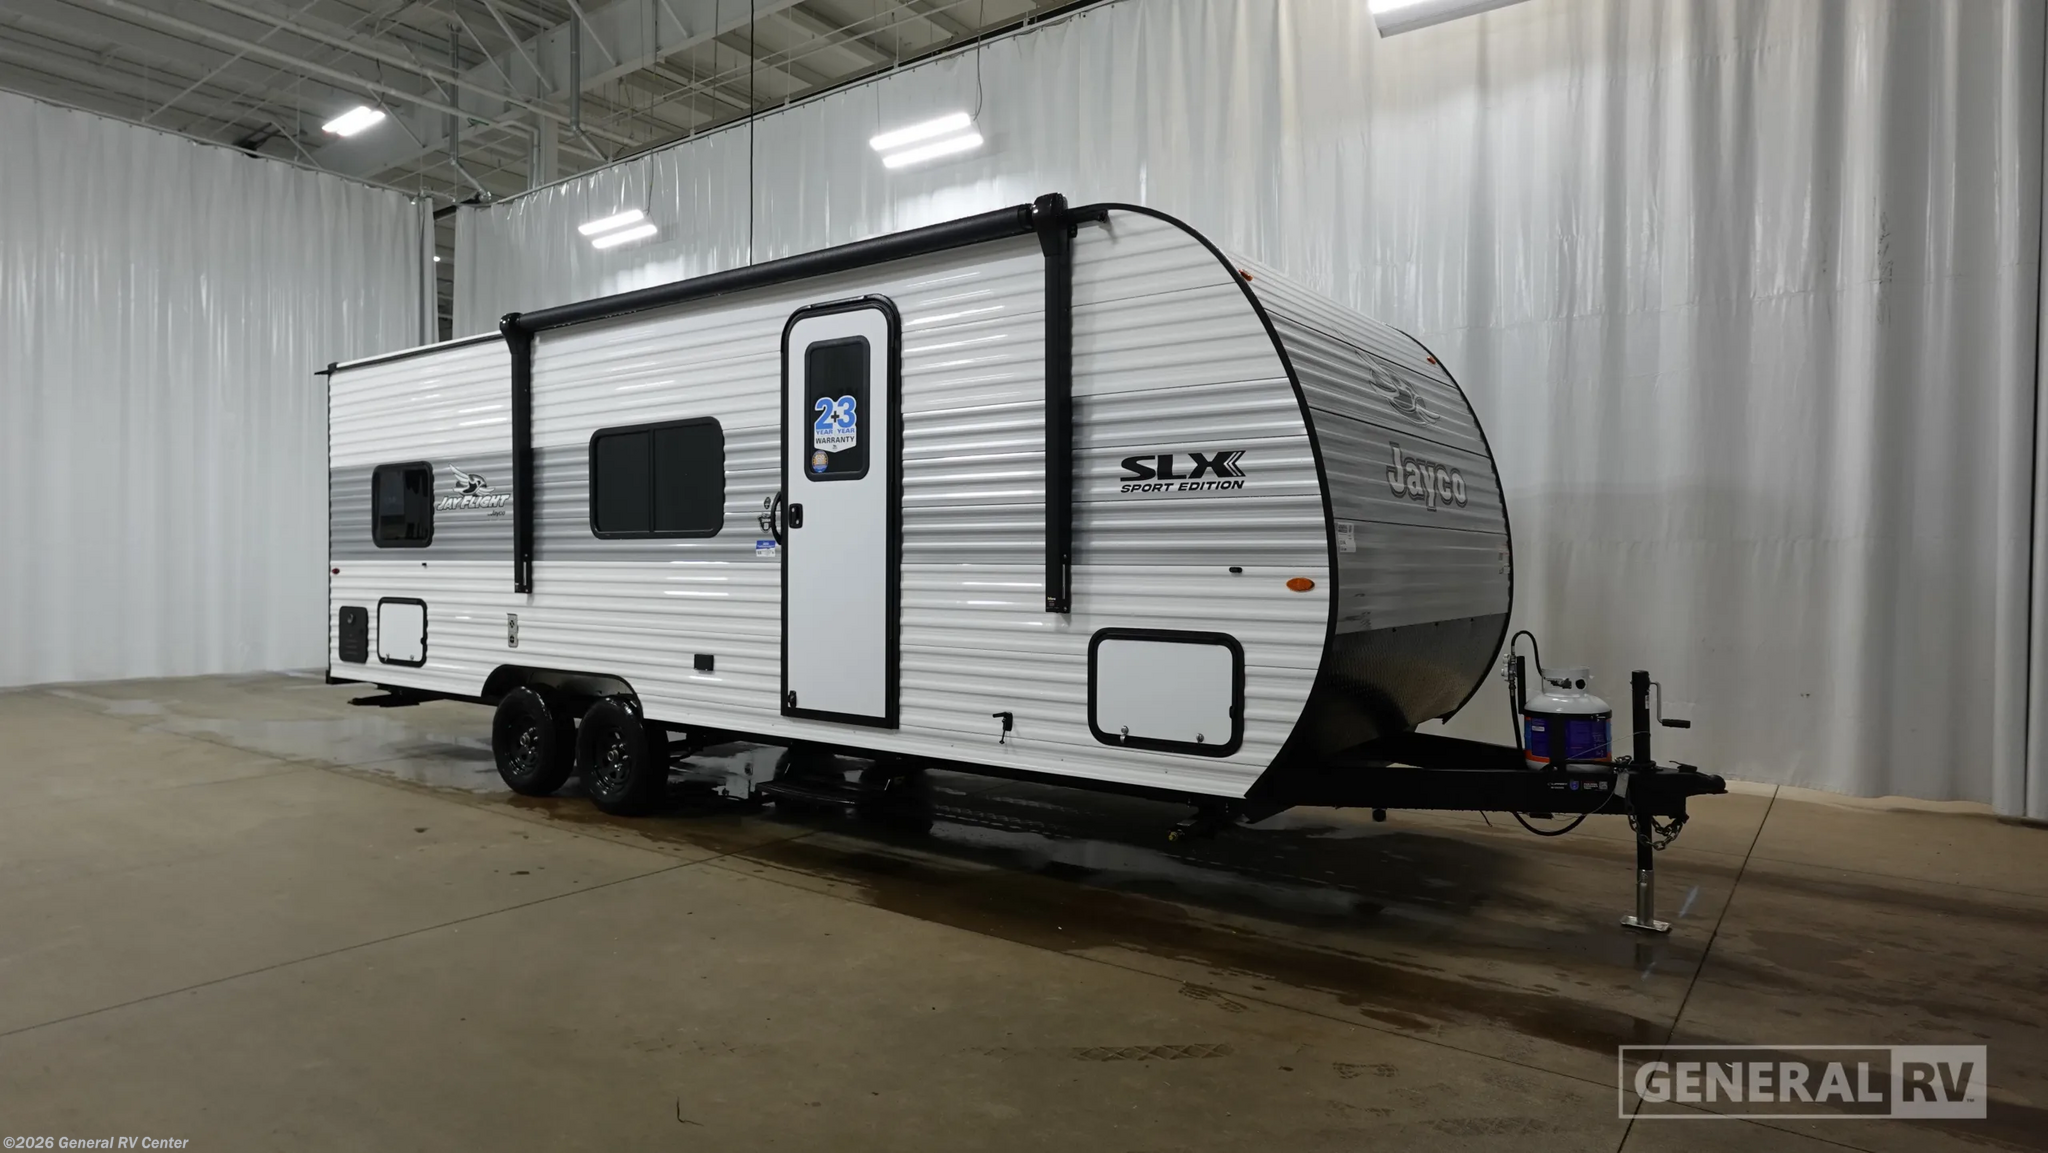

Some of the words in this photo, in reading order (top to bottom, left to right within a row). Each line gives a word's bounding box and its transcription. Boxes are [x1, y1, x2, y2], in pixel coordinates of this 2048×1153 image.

[815, 436, 855, 444] WARRANTY
[1120, 450, 1246, 481] SLX
[1386, 441, 1468, 512] Jayco
[1120, 483, 1174, 493] SPORT
[1178, 480, 1245, 491] EDITION
[436, 496, 461, 511] JAY
[460, 493, 511, 509] FLIGHT
